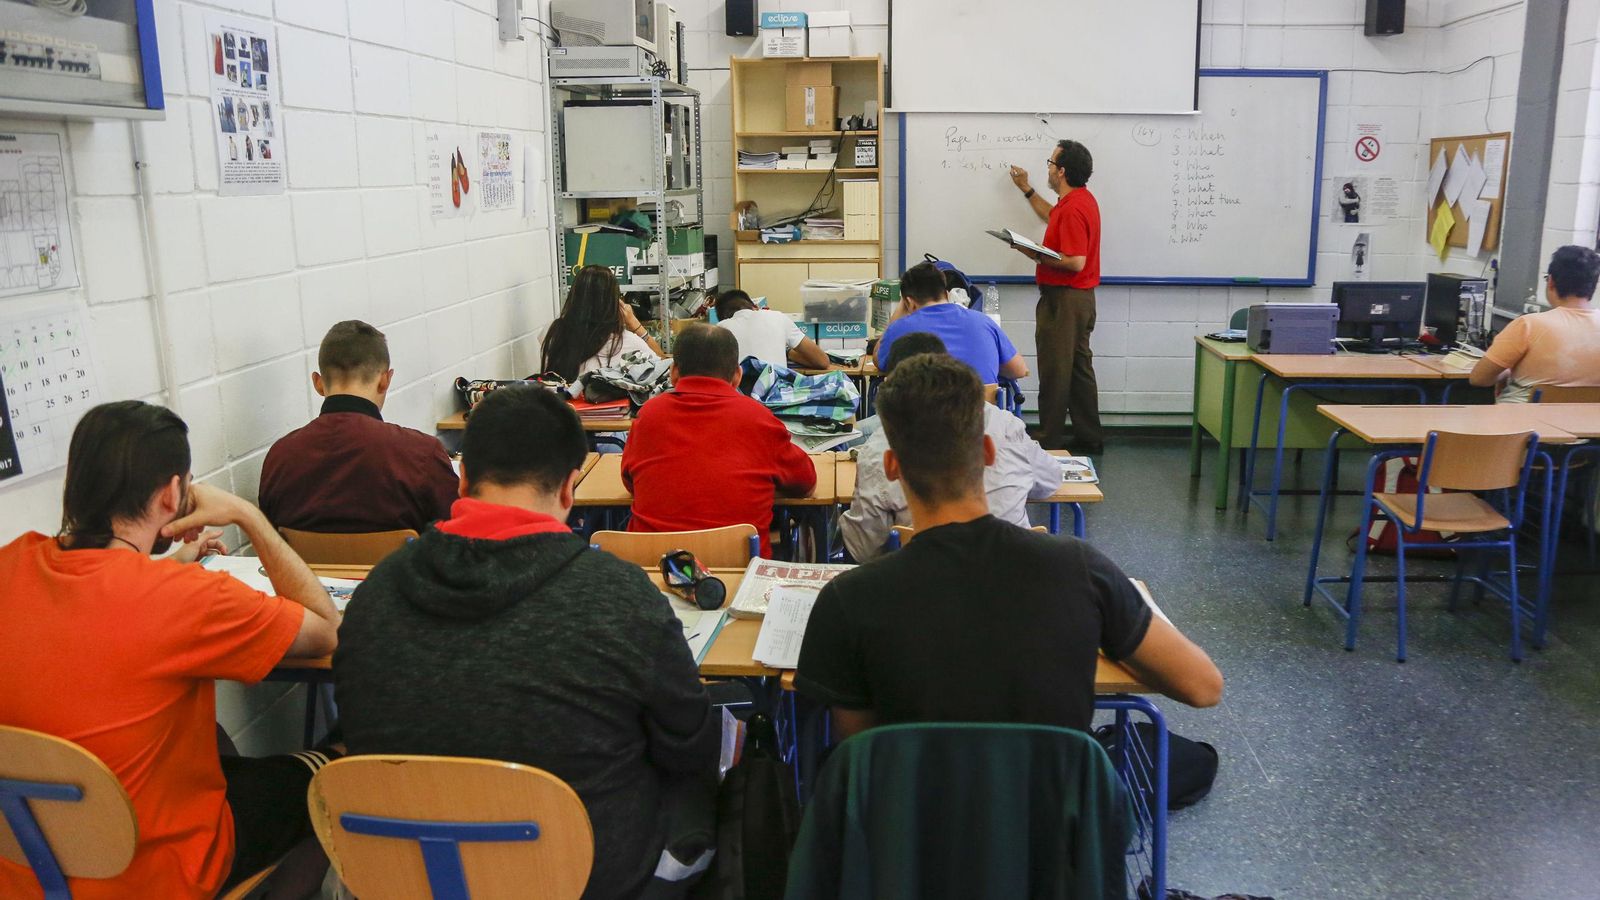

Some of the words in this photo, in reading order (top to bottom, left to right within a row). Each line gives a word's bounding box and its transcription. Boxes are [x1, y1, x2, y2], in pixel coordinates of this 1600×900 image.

[767, 13, 799, 24] eclipse
[1188, 121, 1226, 141] When
[945, 126, 971, 152] Page
[997, 132, 1034, 143] exercise
[1188, 144, 1225, 156] What
[981, 156, 992, 169] he
[1188, 182, 1215, 193] What
[1188, 194, 1215, 206] What
[1218, 192, 1241, 205] time
[1186, 219, 1208, 230] Who
[826, 323, 861, 334] eclipse
[33, 335, 38, 343] 4
[49, 332, 55, 340] 5
[66, 329, 72, 337] 6
[20, 360, 29, 370] 10
[37, 356, 45, 366] 11
[71, 348, 81, 358] 13
[6, 387, 16, 397] 16
[24, 381, 32, 392] 17
[41, 377, 51, 387] 18
[59, 373, 68, 383] 19
[76, 369, 86, 379] 20
[10, 408, 20, 419] 23
[46, 398, 56, 409] 25
[64, 394, 73, 404] 26
[81, 389, 90, 399] 27
[15, 430, 25, 441] 30
[33, 425, 42, 435] 31
[0, 458, 12, 470] 017
